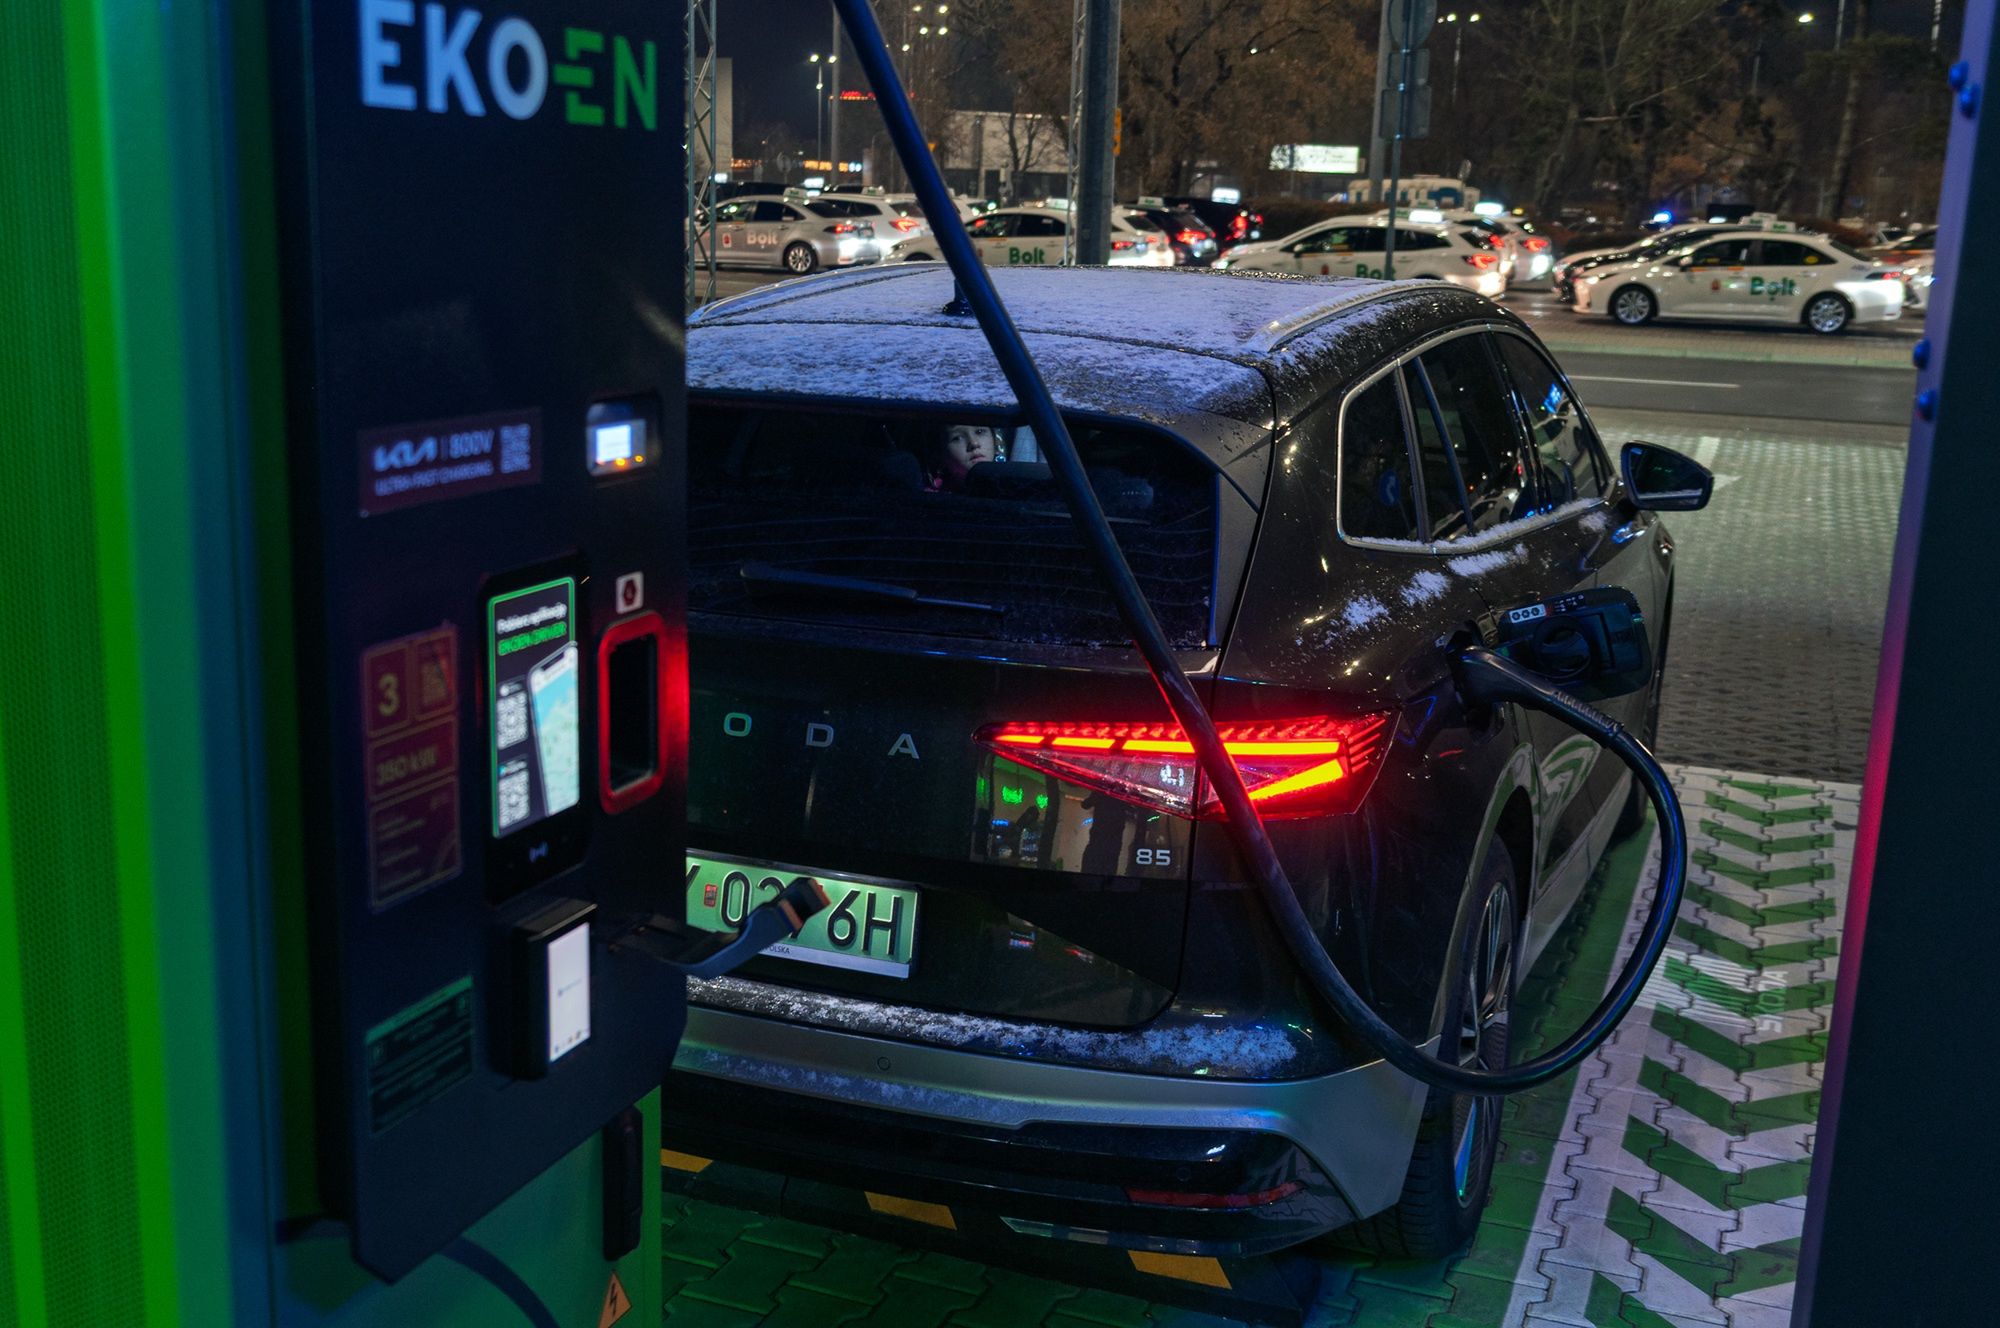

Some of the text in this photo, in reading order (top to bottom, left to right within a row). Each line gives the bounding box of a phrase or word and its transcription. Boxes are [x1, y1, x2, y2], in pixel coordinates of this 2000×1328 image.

[745, 231, 778, 248] Bolt
[1008, 247, 1045, 265] Bolt
[1355, 263, 1396, 280] Bo
[1750, 277, 1796, 299] Bolt
[377, 673, 401, 718] 3
[1136, 848, 1171, 866] 85
[720, 869, 902, 957] 06H
[767, 944, 791, 954] OLSKA
